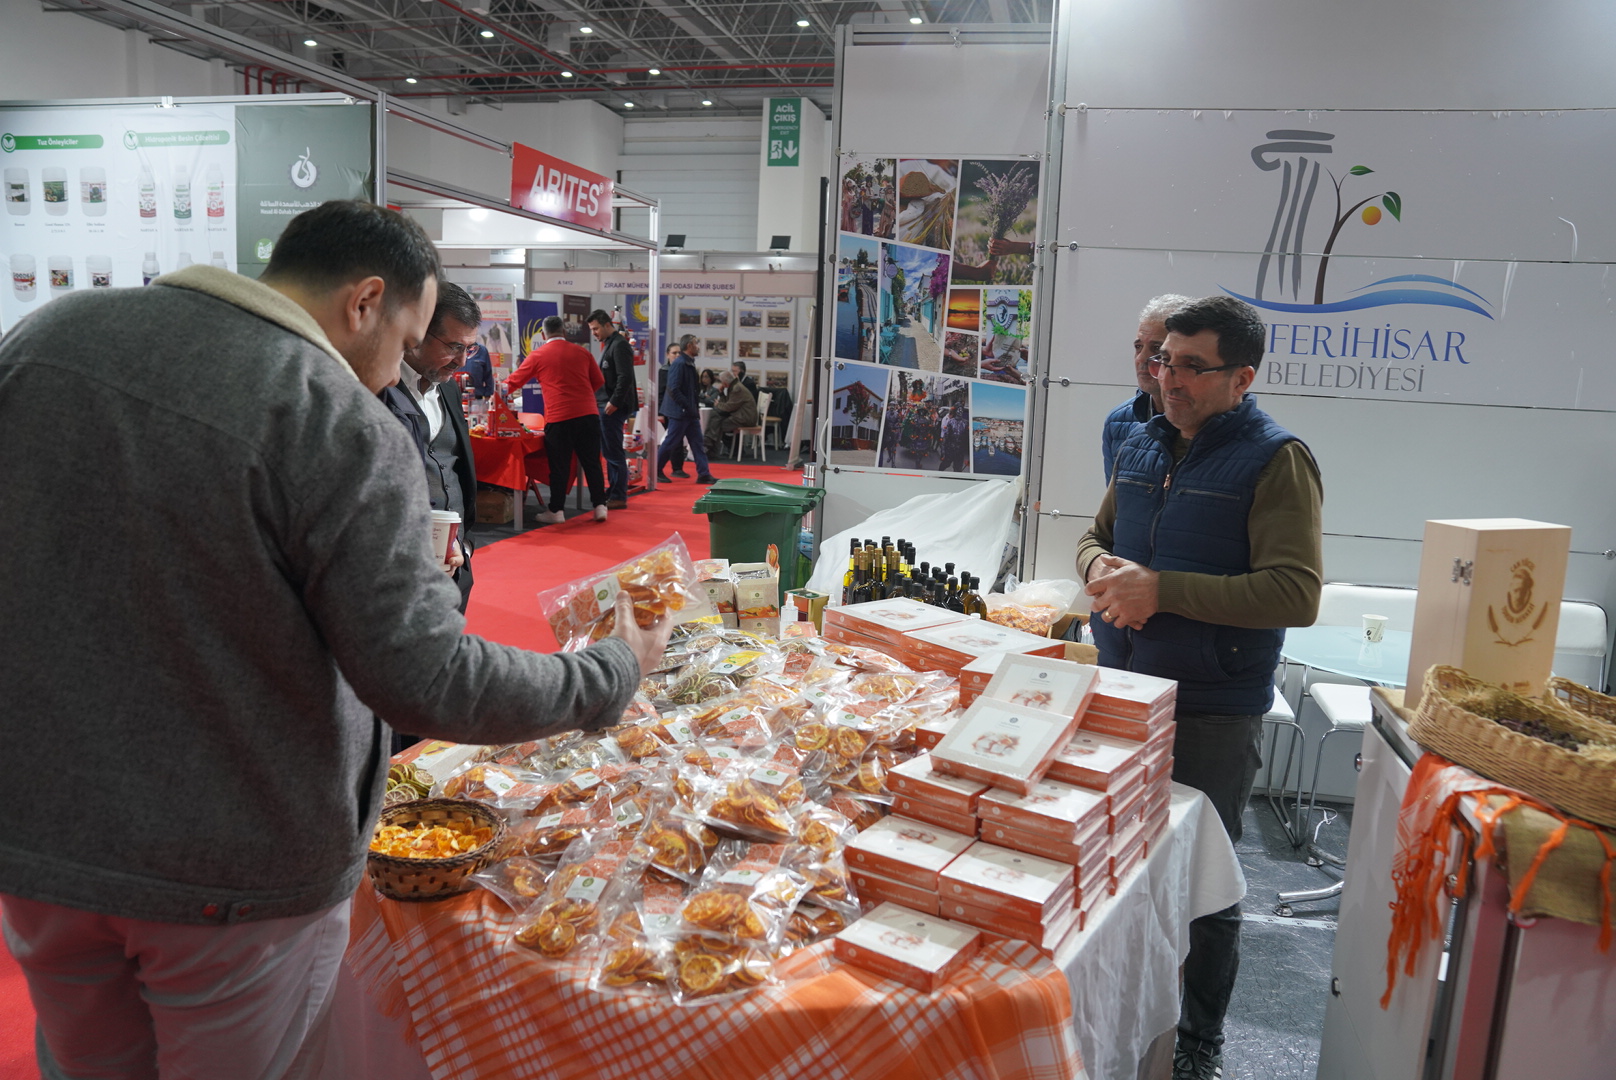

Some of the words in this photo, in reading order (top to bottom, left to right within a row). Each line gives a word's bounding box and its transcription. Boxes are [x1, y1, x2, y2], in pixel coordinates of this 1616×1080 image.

[776, 103, 795, 112] ACİL
[774, 114, 796, 123] ÇIKIŞ
[48, 138, 78, 146] Önleyiciler
[1266, 361, 1425, 392] BELEDİYESİ
